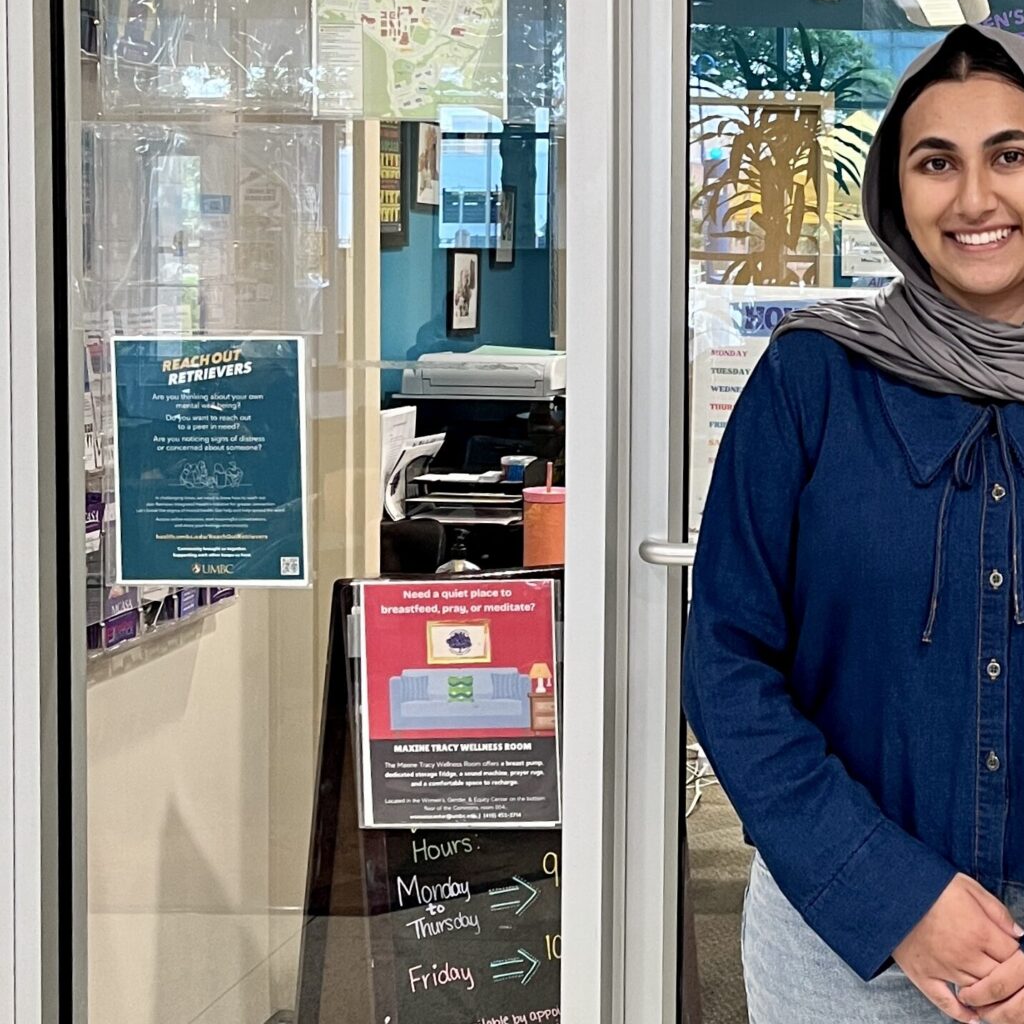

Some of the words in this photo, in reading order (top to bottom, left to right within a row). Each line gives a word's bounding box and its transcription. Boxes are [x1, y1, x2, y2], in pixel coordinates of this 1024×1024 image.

[710, 349, 748, 357] MONDAY
[162, 354, 210, 372] REACH
[211, 348, 242, 364] OUT
[167, 361, 253, 386] RETRIEVERS
[710, 367, 751, 375] TUESDAY
[202, 564, 235, 574] UMBC
[403, 589, 431, 599] Need
[432, 591, 439, 599] a
[441, 589, 468, 600] quiet
[470, 589, 499, 599] place
[500, 589, 512, 597] to
[380, 604, 441, 614] breastfeed,
[442, 605, 469, 614] pray,
[470, 604, 482, 612] or
[483, 602, 536, 612] meditate?
[393, 744, 430, 753] MAXINE
[430, 743, 459, 752] TRACY
[460, 743, 503, 752] WELLNESS
[504, 742, 532, 751] ROOM
[412, 833, 481, 864] Hours:
[396, 874, 471, 907] Monday
[425, 903, 445, 916] to
[406, 911, 481, 940] Thursday
[408, 962, 476, 993] Friday
